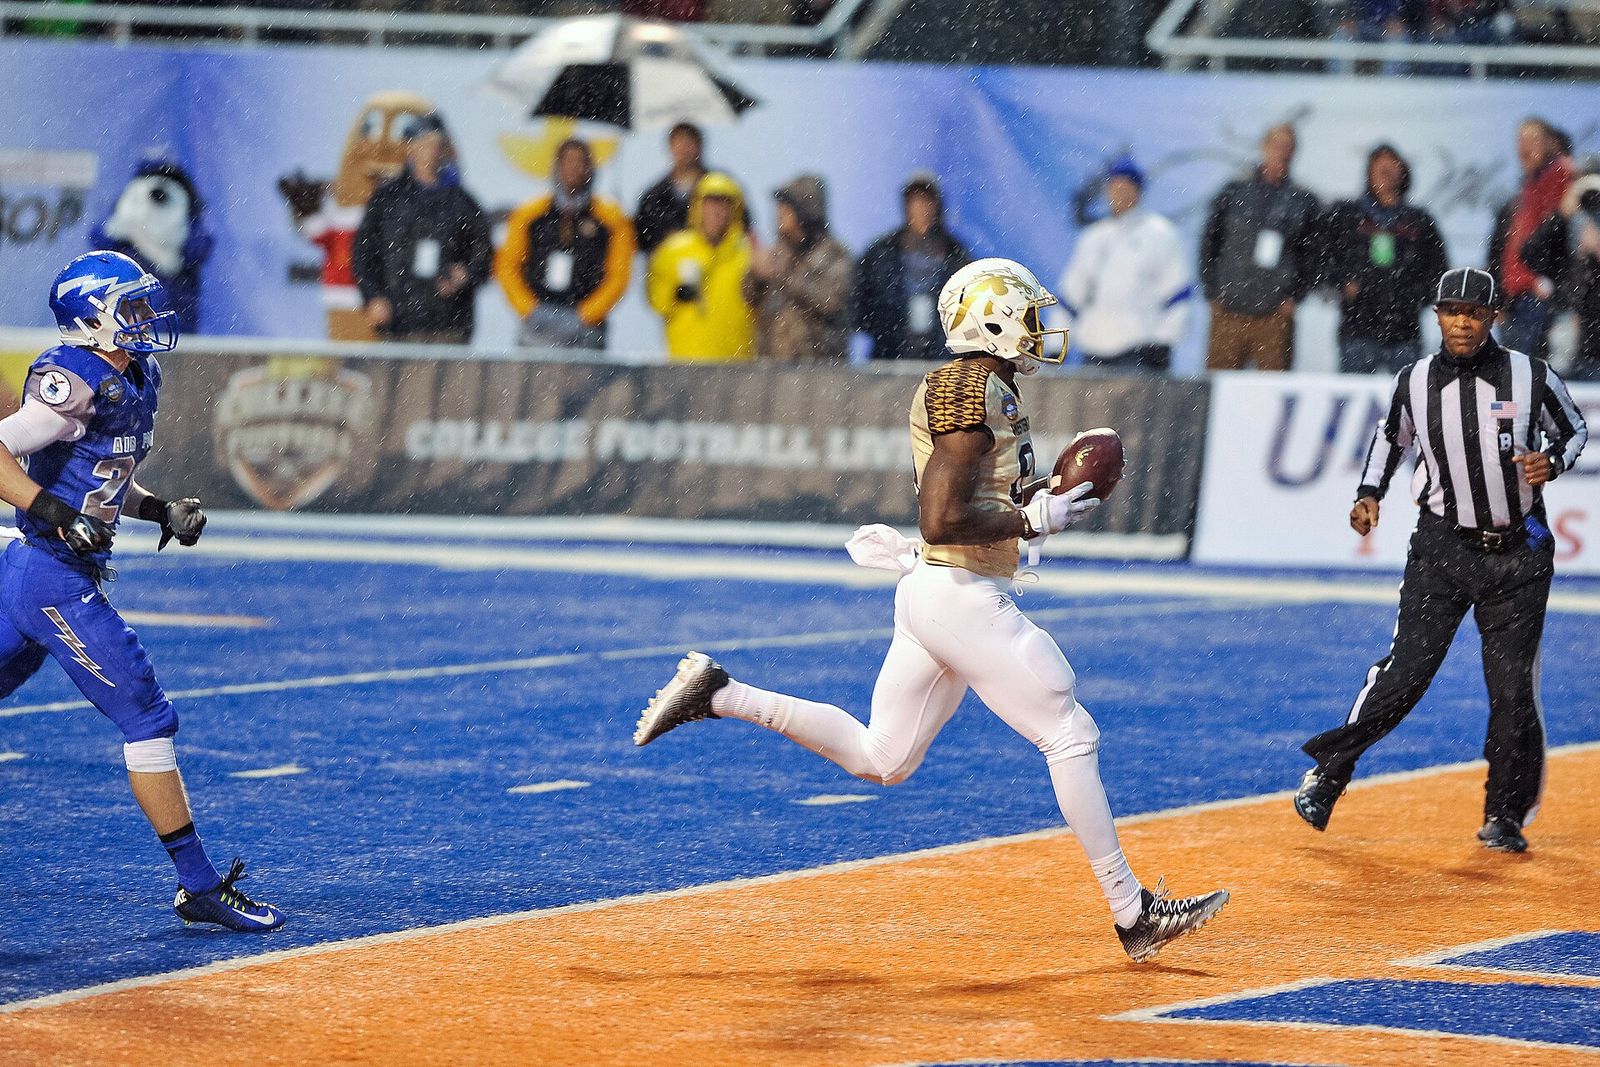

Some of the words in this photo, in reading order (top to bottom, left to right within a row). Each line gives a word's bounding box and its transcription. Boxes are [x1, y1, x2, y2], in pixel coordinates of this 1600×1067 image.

[405, 418, 588, 462] COLLEGE
[596, 420, 816, 469] FOOTBALL
[1499, 433, 1512, 452] B
